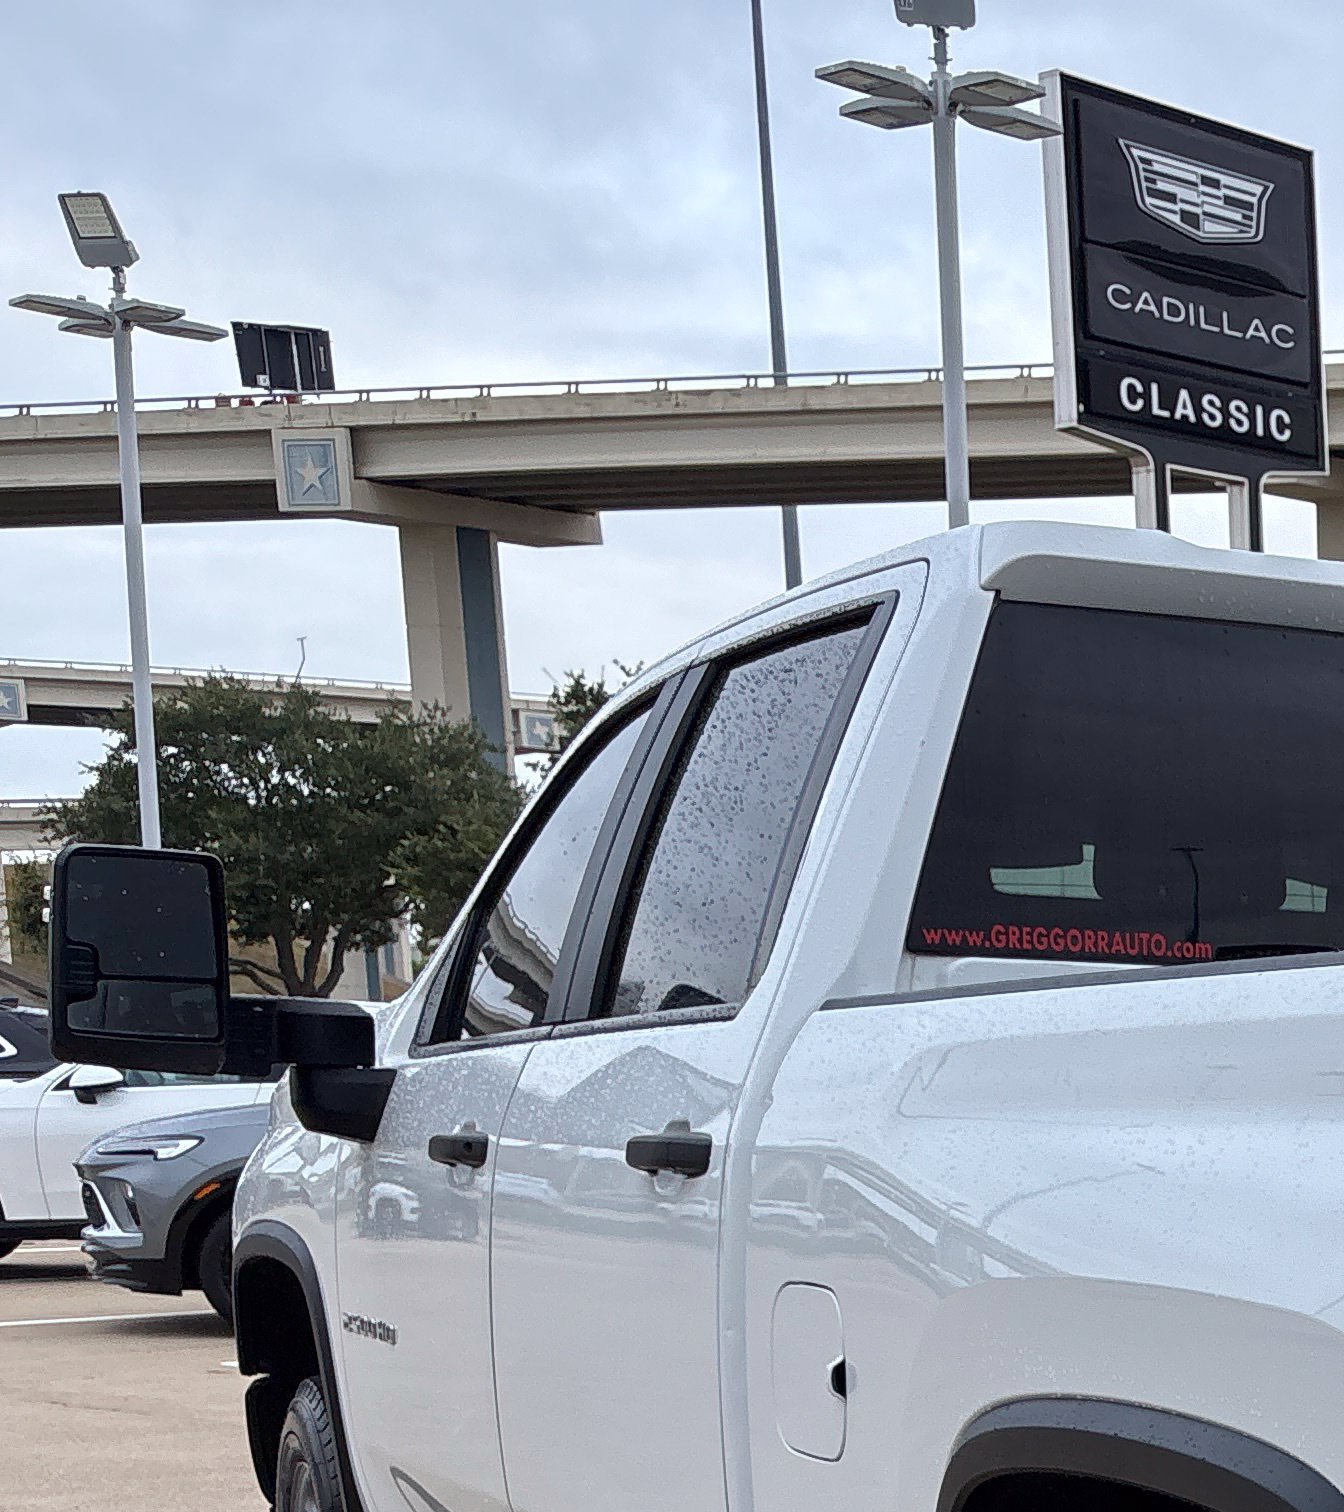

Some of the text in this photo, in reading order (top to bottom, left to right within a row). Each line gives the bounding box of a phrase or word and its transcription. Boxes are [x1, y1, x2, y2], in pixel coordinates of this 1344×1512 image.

[1106, 283, 1296, 349] CADILLAC
[1119, 375, 1293, 442] CLASSIC
[922, 924, 1213, 959] www.GREGGORRAUTO.com
